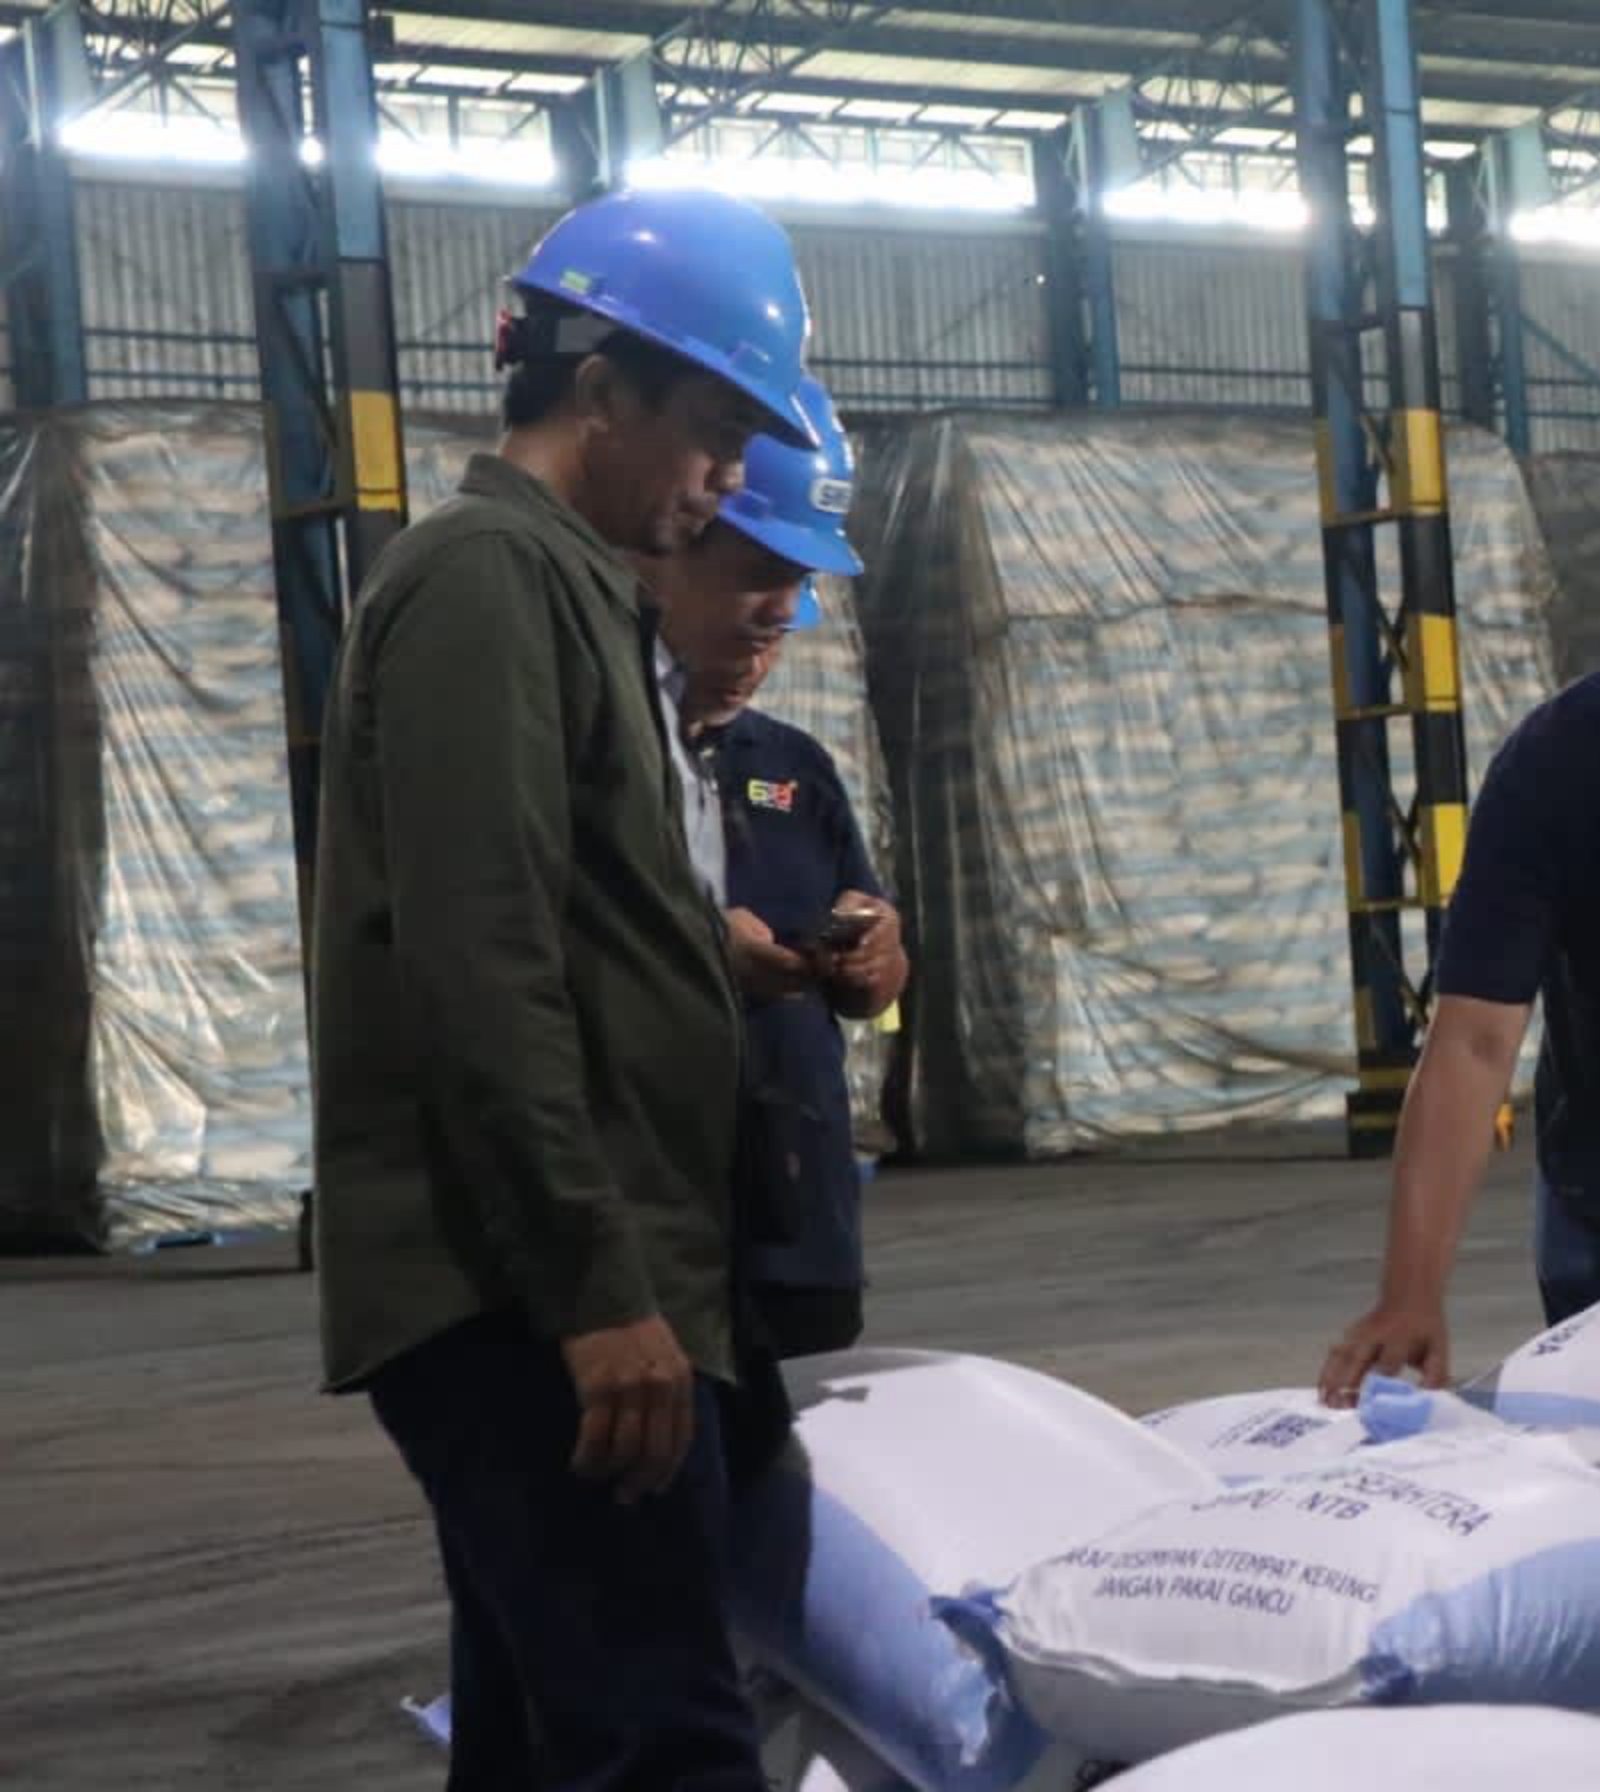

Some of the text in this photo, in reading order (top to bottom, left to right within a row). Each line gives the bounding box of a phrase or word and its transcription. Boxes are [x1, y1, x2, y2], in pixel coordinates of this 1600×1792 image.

[1299, 1490, 1370, 1520] NTB
[1092, 1573, 1295, 1616] JANGAN PAKAI GANCU
[1202, 1548, 1299, 1578] DITEMPAT
[1300, 1563, 1381, 1603] KERING
